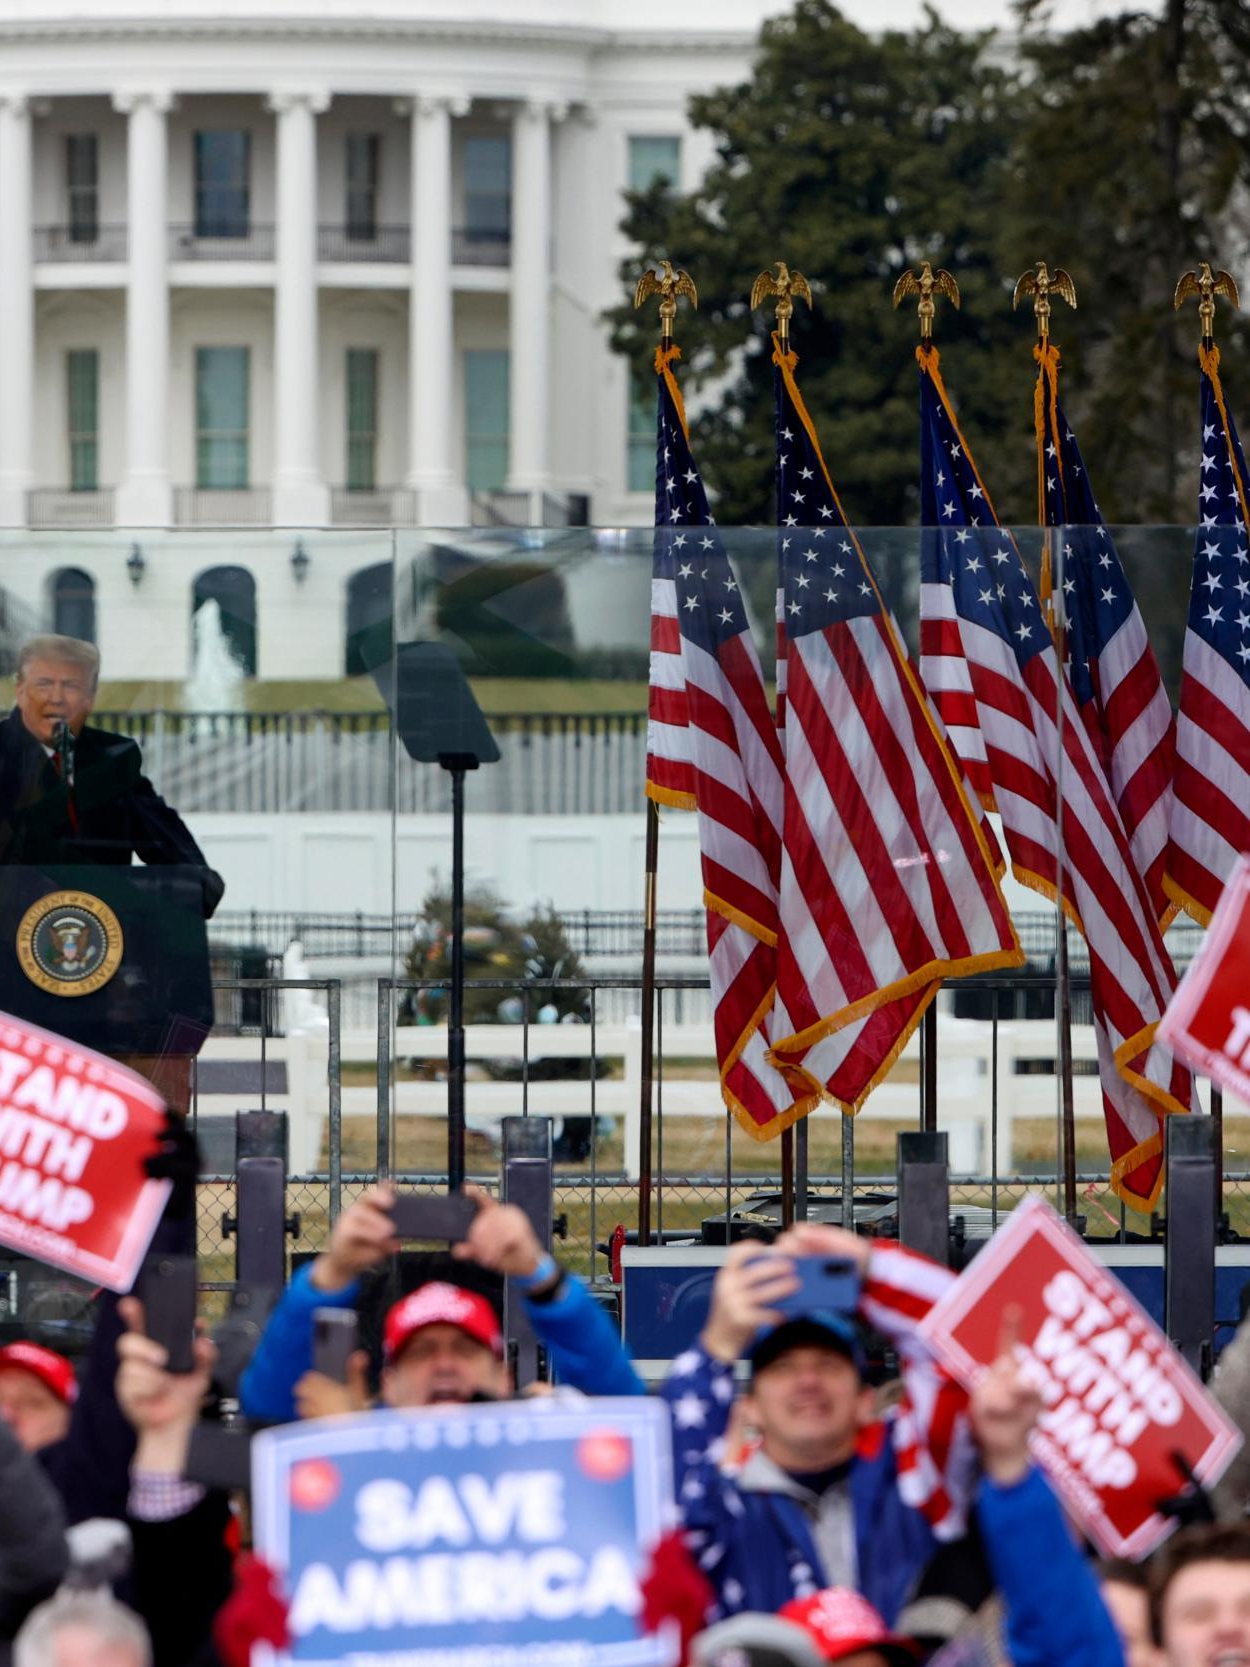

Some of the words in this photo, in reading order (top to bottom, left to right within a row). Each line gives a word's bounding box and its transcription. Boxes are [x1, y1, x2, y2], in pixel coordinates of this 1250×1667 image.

[96, 904, 120, 948] UNITED
[79, 958, 117, 993] STATES
[1033, 1316, 1148, 1445] WITH
[1042, 1270, 1183, 1426] STAND
[1012, 1343, 1137, 1489] UMP
[355, 1471, 565, 1552] SAVE
[288, 1545, 643, 1636] AMERICA
